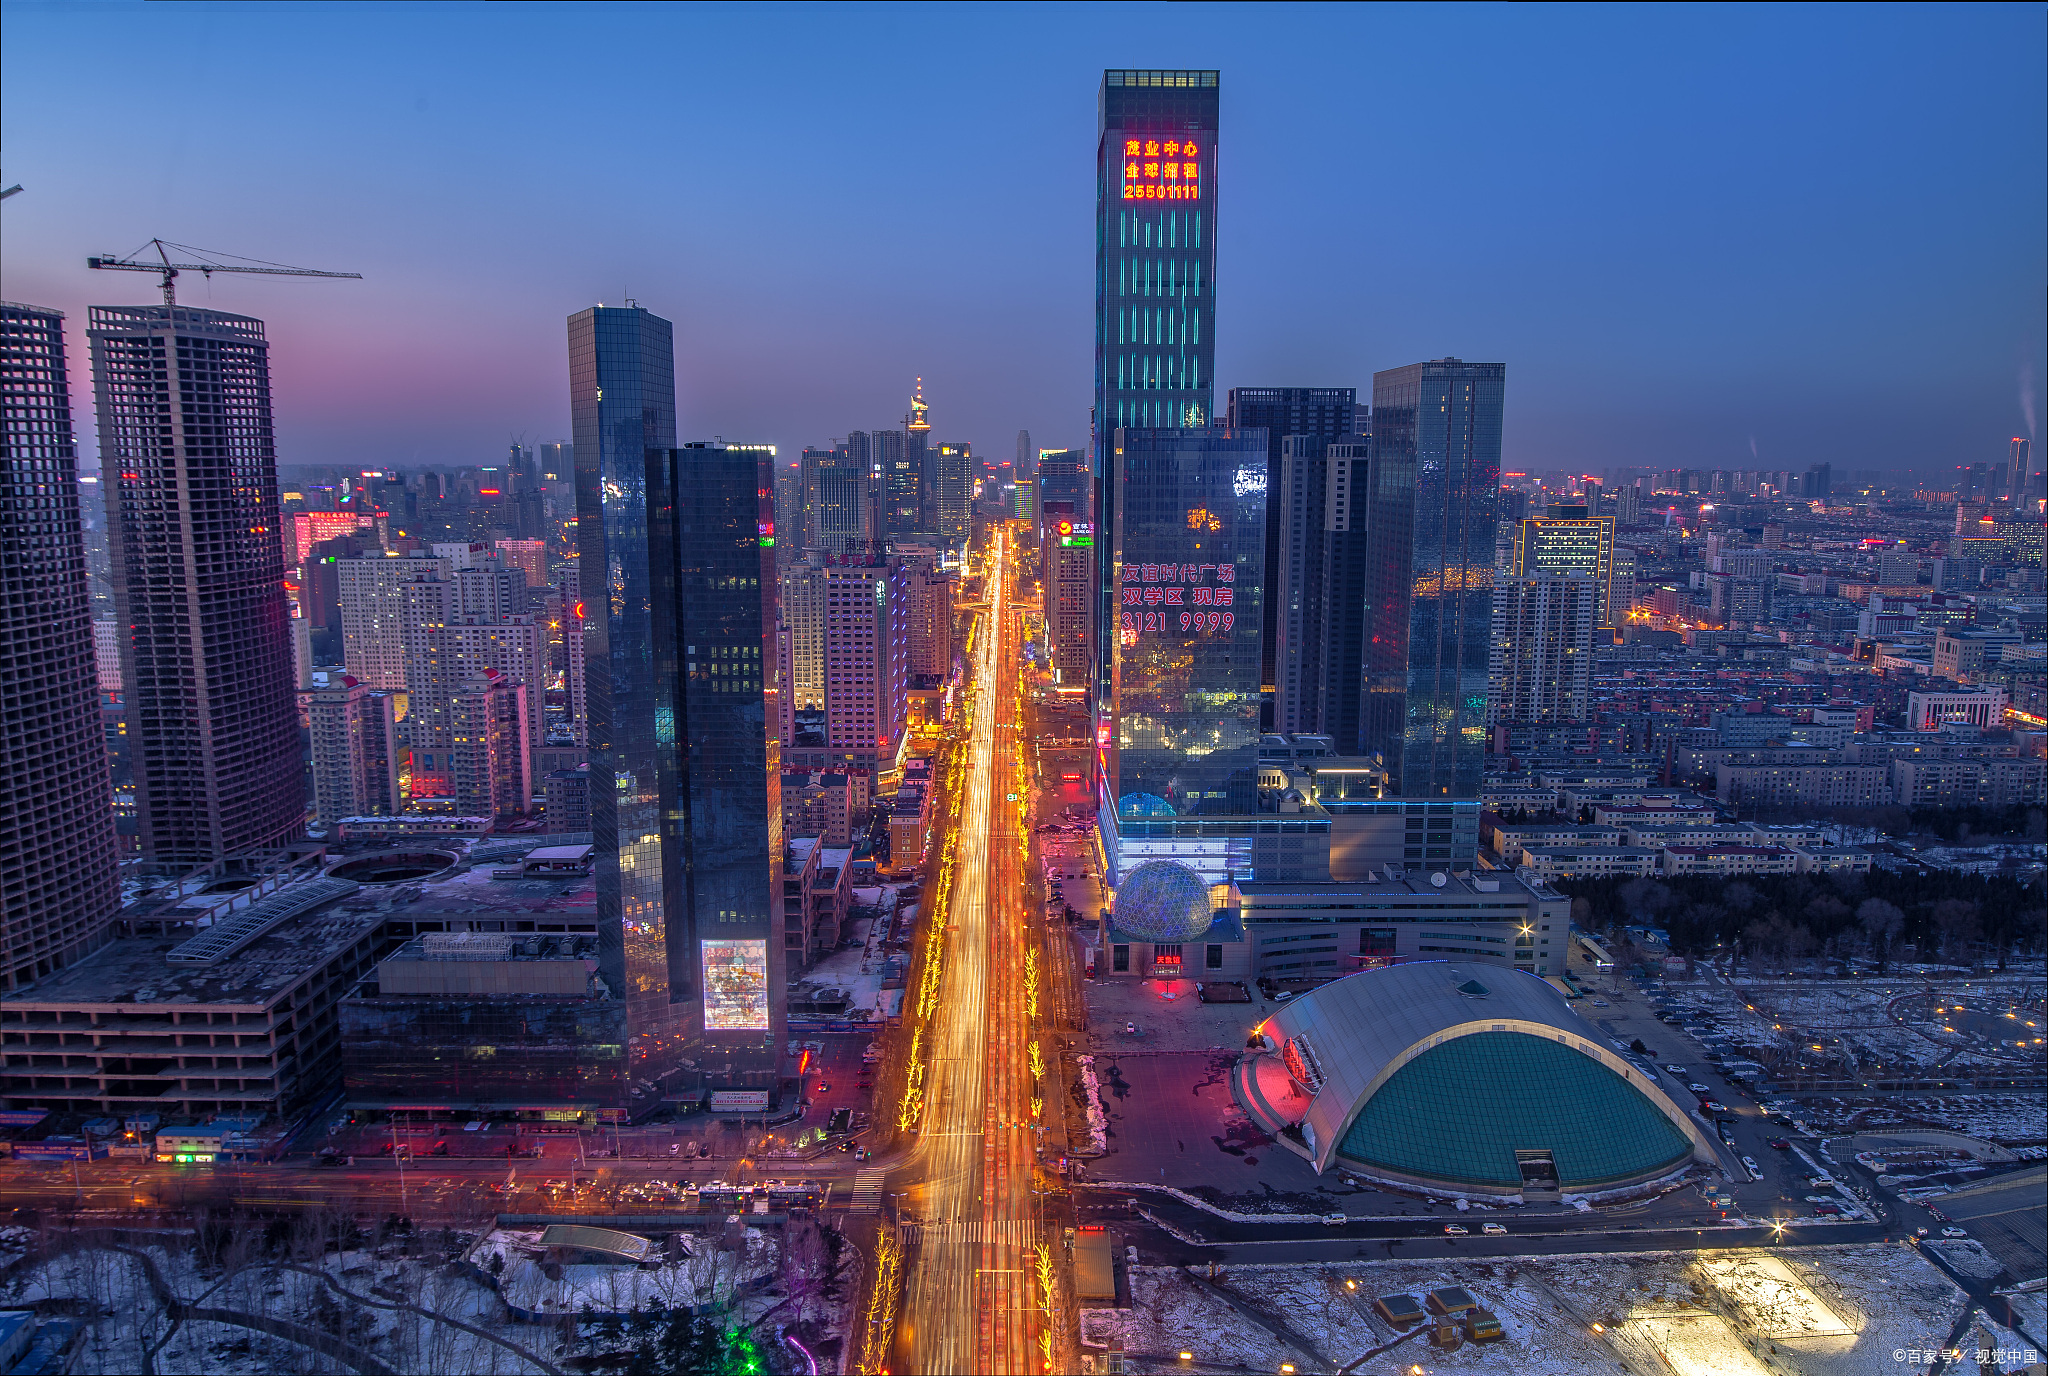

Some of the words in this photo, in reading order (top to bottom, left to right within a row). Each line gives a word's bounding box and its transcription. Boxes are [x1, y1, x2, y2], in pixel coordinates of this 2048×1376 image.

[1126, 140, 1198, 157] 茂业中心
[1126, 162, 1198, 178] 全球招租
[1124, 185, 1198, 199] 25501111
[1122, 563, 1235, 582] 友谊时代广场
[1123, 587, 1184, 606] 双学区
[1193, 587, 1234, 606] 现房
[1121, 612, 1166, 631] 3121
[1180, 612, 1235, 631] 9999
